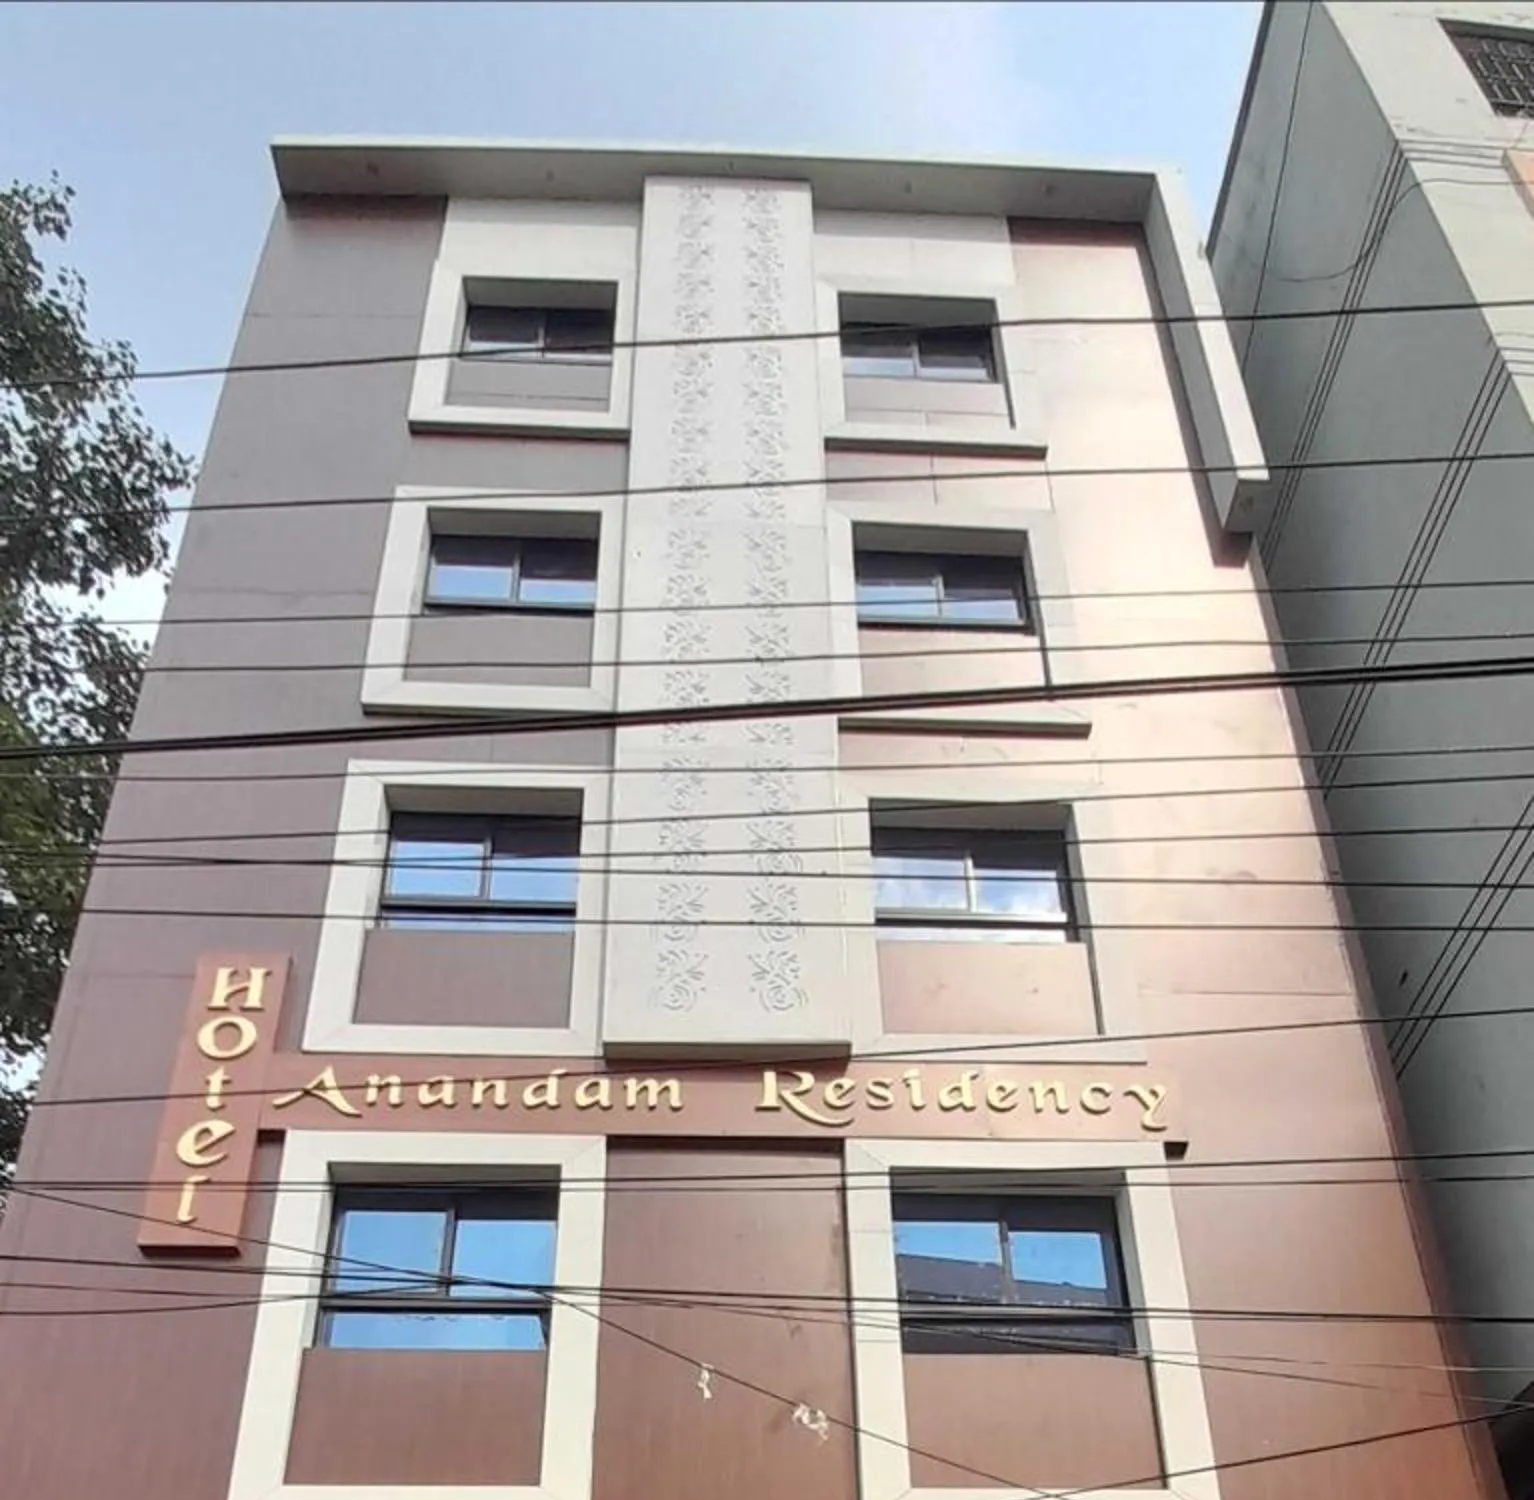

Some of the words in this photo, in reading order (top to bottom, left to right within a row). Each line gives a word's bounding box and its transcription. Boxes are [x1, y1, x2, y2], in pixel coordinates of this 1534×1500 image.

[176, 966, 273, 1226] Hotel
[273, 1067, 684, 1118] Anandam
[755, 1068, 1168, 1132] Residency
